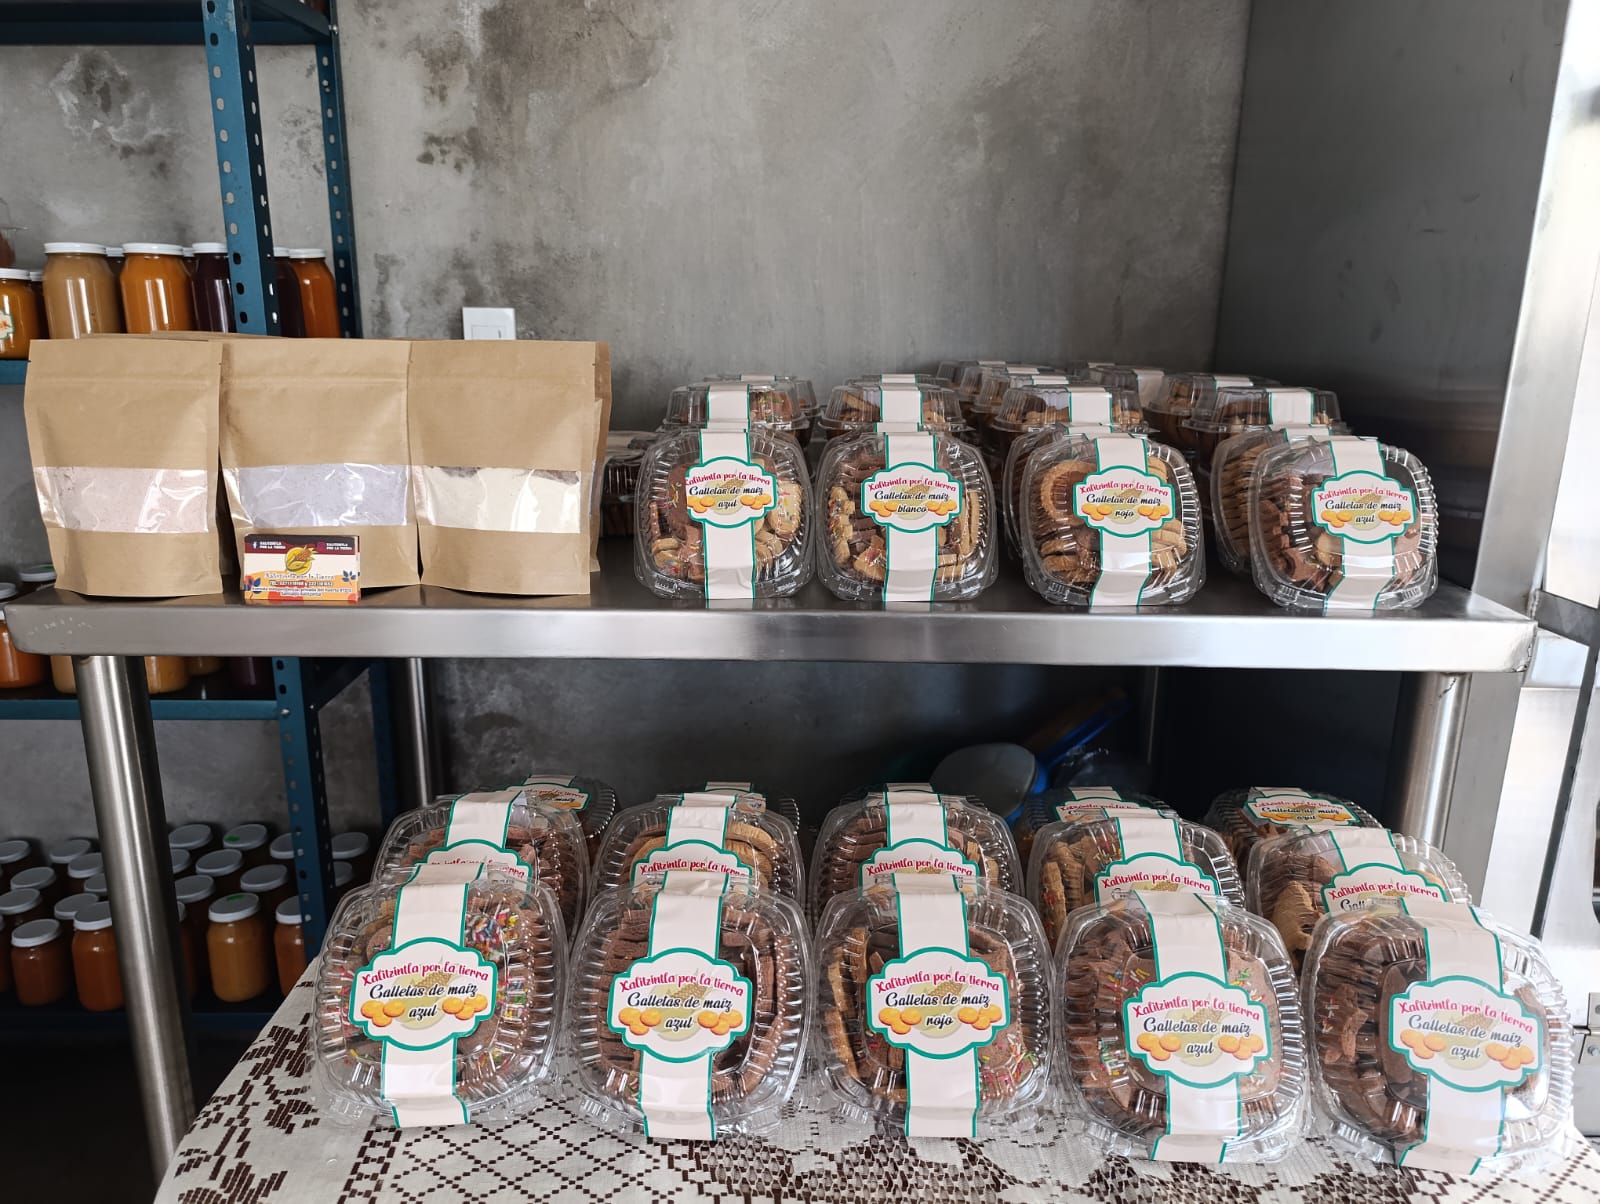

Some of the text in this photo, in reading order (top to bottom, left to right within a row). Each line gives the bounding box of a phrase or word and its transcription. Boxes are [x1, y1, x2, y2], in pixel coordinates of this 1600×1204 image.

[750, 473, 770, 485] tierra
[689, 486, 727, 495] Galletas
[875, 491, 912, 500] Galletas
[915, 492, 925, 500] de
[718, 500, 737, 509] azul
[1086, 494, 1124, 503] Galletas
[1325, 500, 1364, 509] Galletas
[898, 505, 927, 513] blanco
[1115, 510, 1134, 519] rojo
[1356, 516, 1375, 524] azul
[640, 859, 687, 875] Xalitzintla
[690, 861, 706, 871] por
[708, 861, 718, 870] la
[866, 858, 973, 876] Xalitzintla por la tierra
[1102, 872, 1210, 891] Xalitzintla por la tierra
[1328, 882, 1438, 900] Xalitzintla por la tierra
[362, 962, 489, 986] Xalitzintla por la tierra
[620, 972, 744, 996] Xalitzintla por la tierra
[876, 971, 1000, 993] Xalitzintla por la tierra
[370, 984, 424, 999] Galletas
[429, 984, 444, 996] de
[628, 992, 680, 1007] Galletas
[685, 997, 699, 1007] de
[886, 992, 938, 1007] Galletas
[943, 994, 957, 1005] de
[409, 1005, 438, 1020] azul
[1132, 996, 1260, 1020] Xalitzintla por la tierra
[666, 1017, 692, 1031] azul
[926, 1015, 954, 1029] rojo
[1399, 999, 1533, 1034] Xalitzintla por la tierra
[1144, 1017, 1198, 1032] Galletas
[1199, 1021, 1217, 1033] de
[1409, 1015, 1466, 1036] Galletas
[1470, 1026, 1487, 1039] de
[1186, 1042, 1214, 1057] azul
[1452, 1046, 1481, 1061] azul
